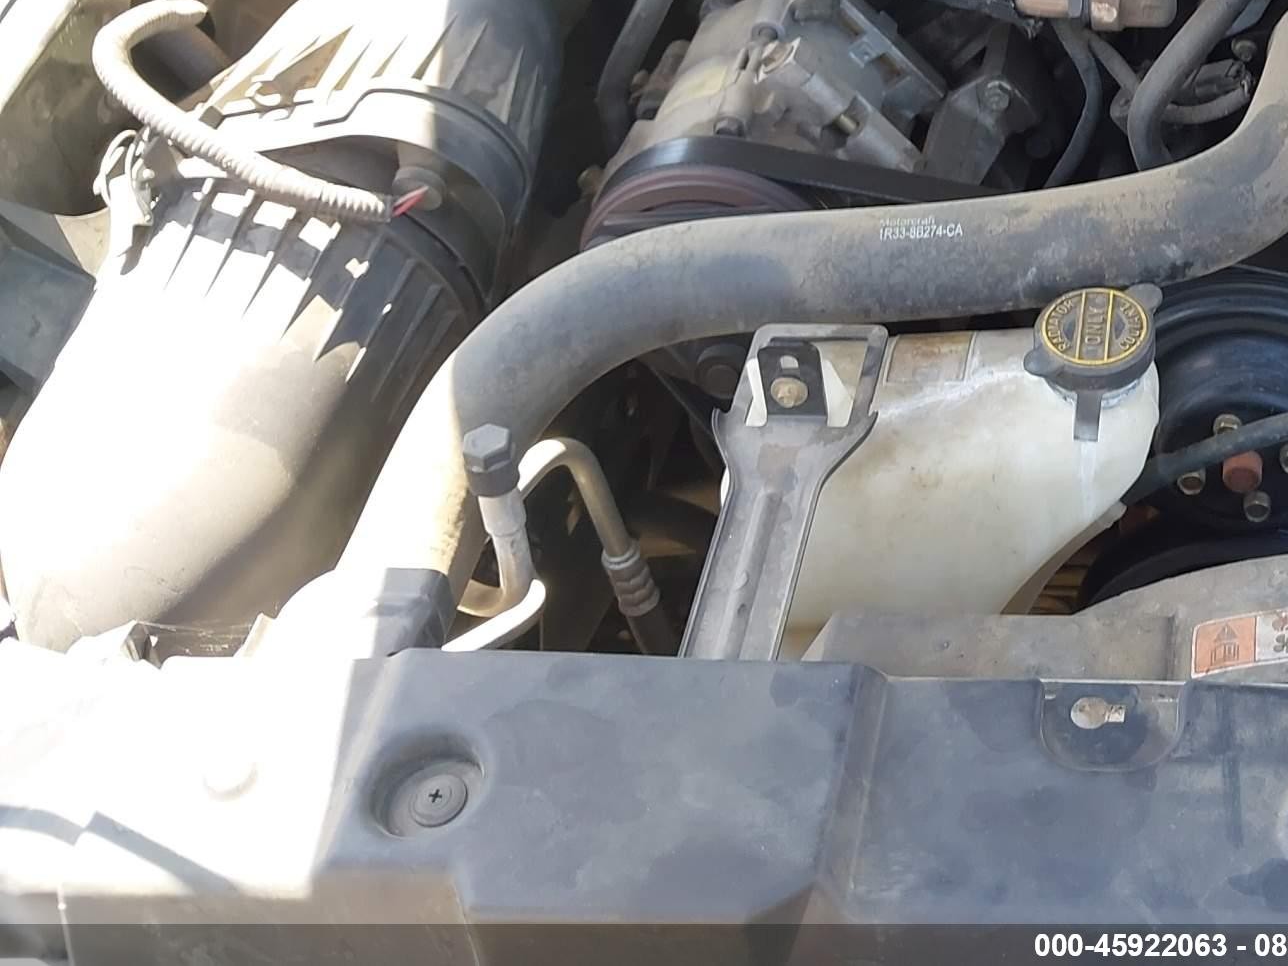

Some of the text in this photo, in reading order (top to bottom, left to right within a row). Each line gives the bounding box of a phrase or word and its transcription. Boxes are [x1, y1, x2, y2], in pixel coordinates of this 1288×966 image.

[1047, 298, 1074, 351] RADIATOR
[1084, 305, 1105, 346] ONLY
[1118, 301, 1141, 350] COOLANT
